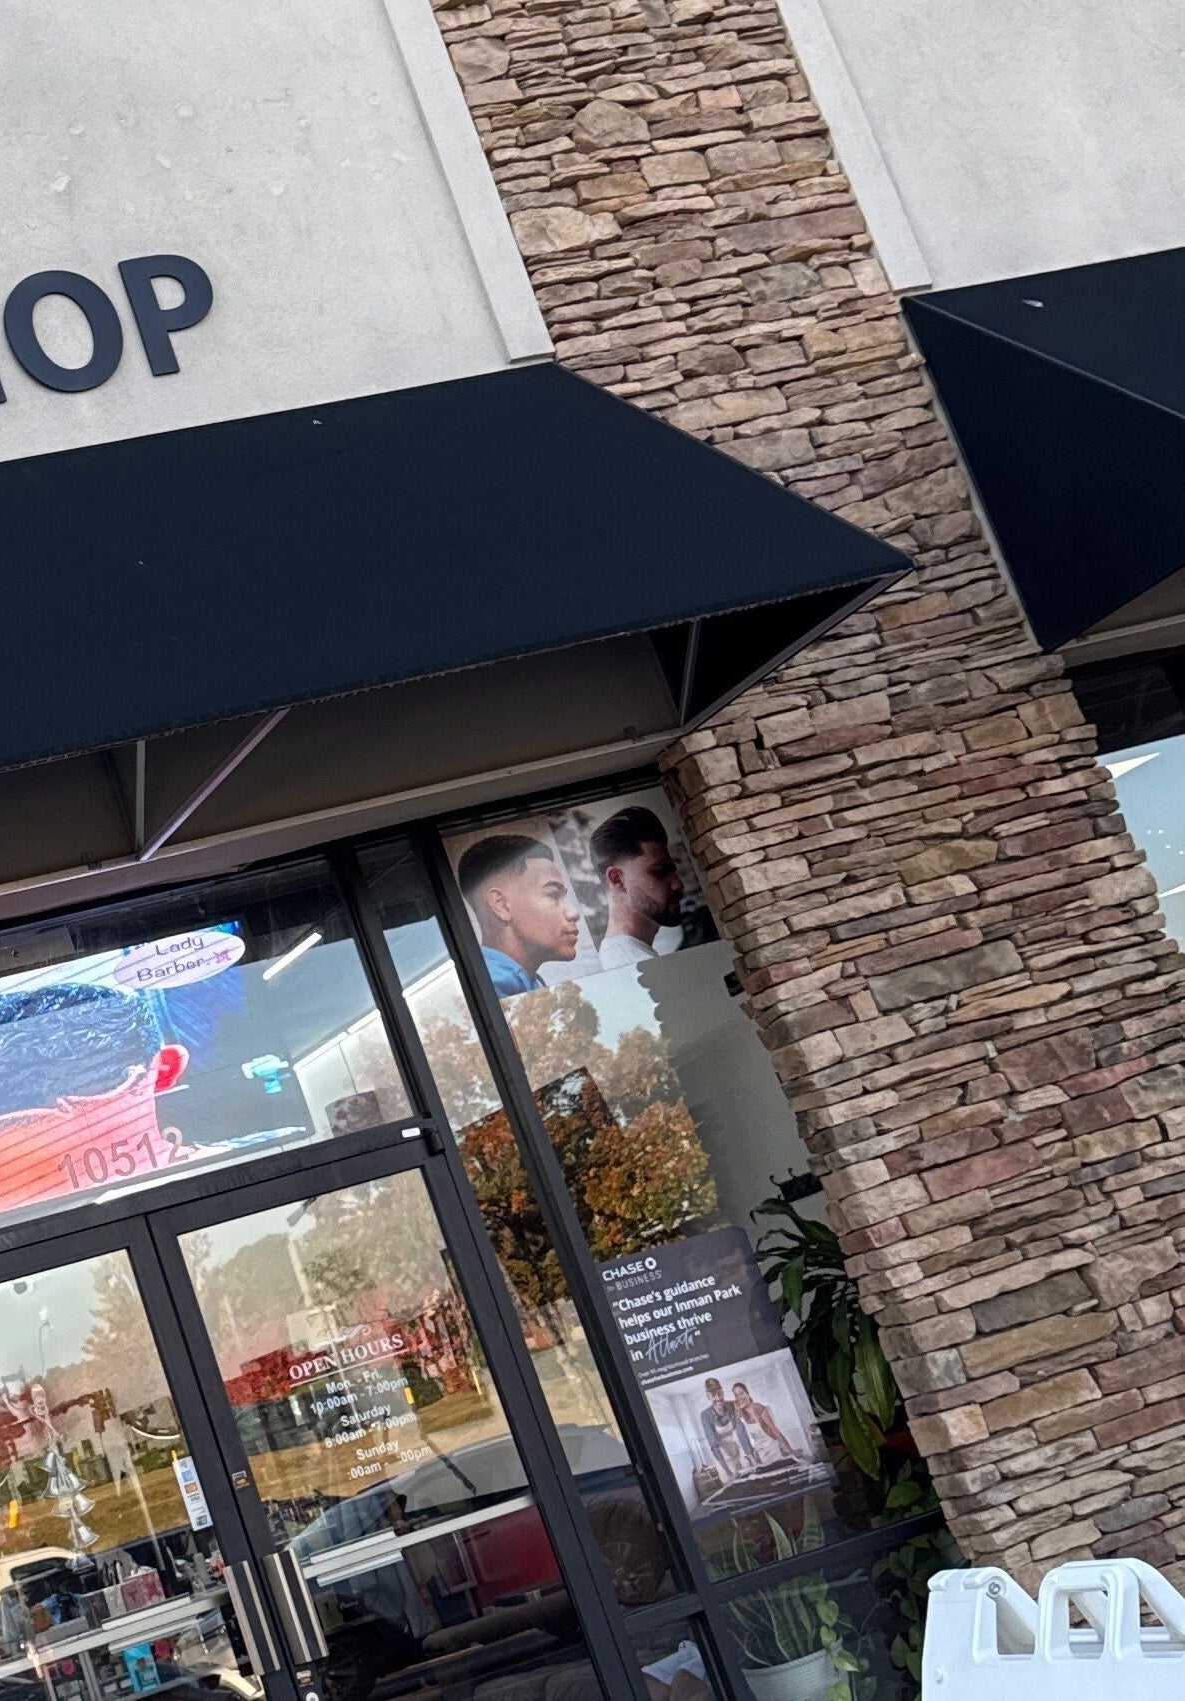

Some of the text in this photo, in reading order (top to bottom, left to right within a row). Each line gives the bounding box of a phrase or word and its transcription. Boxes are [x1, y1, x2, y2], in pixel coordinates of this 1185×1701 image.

[155, 936, 204, 957] Lady
[57, 1126, 190, 1188] 10512
[602, 1261, 646, 1281] CHASE
[615, 1270, 662, 1291] BUSINESS
[664, 1275, 716, 1301] guidance
[618, 1283, 743, 1330] helps our Inman Park
[623, 1311, 713, 1346] business thrive
[289, 1333, 404, 1381] OPEN HOURS
[630, 1350, 644, 1362] in
[310, 1391, 359, 1415] 10:00am
[365, 1377, 409, 1398] 7:00pm
[340, 1403, 392, 1428] Saturday
[324, 1428, 367, 1449] 8:00am
[373, 1412, 417, 1433] 7:00pm
[356, 1440, 400, 1462] Sunday
